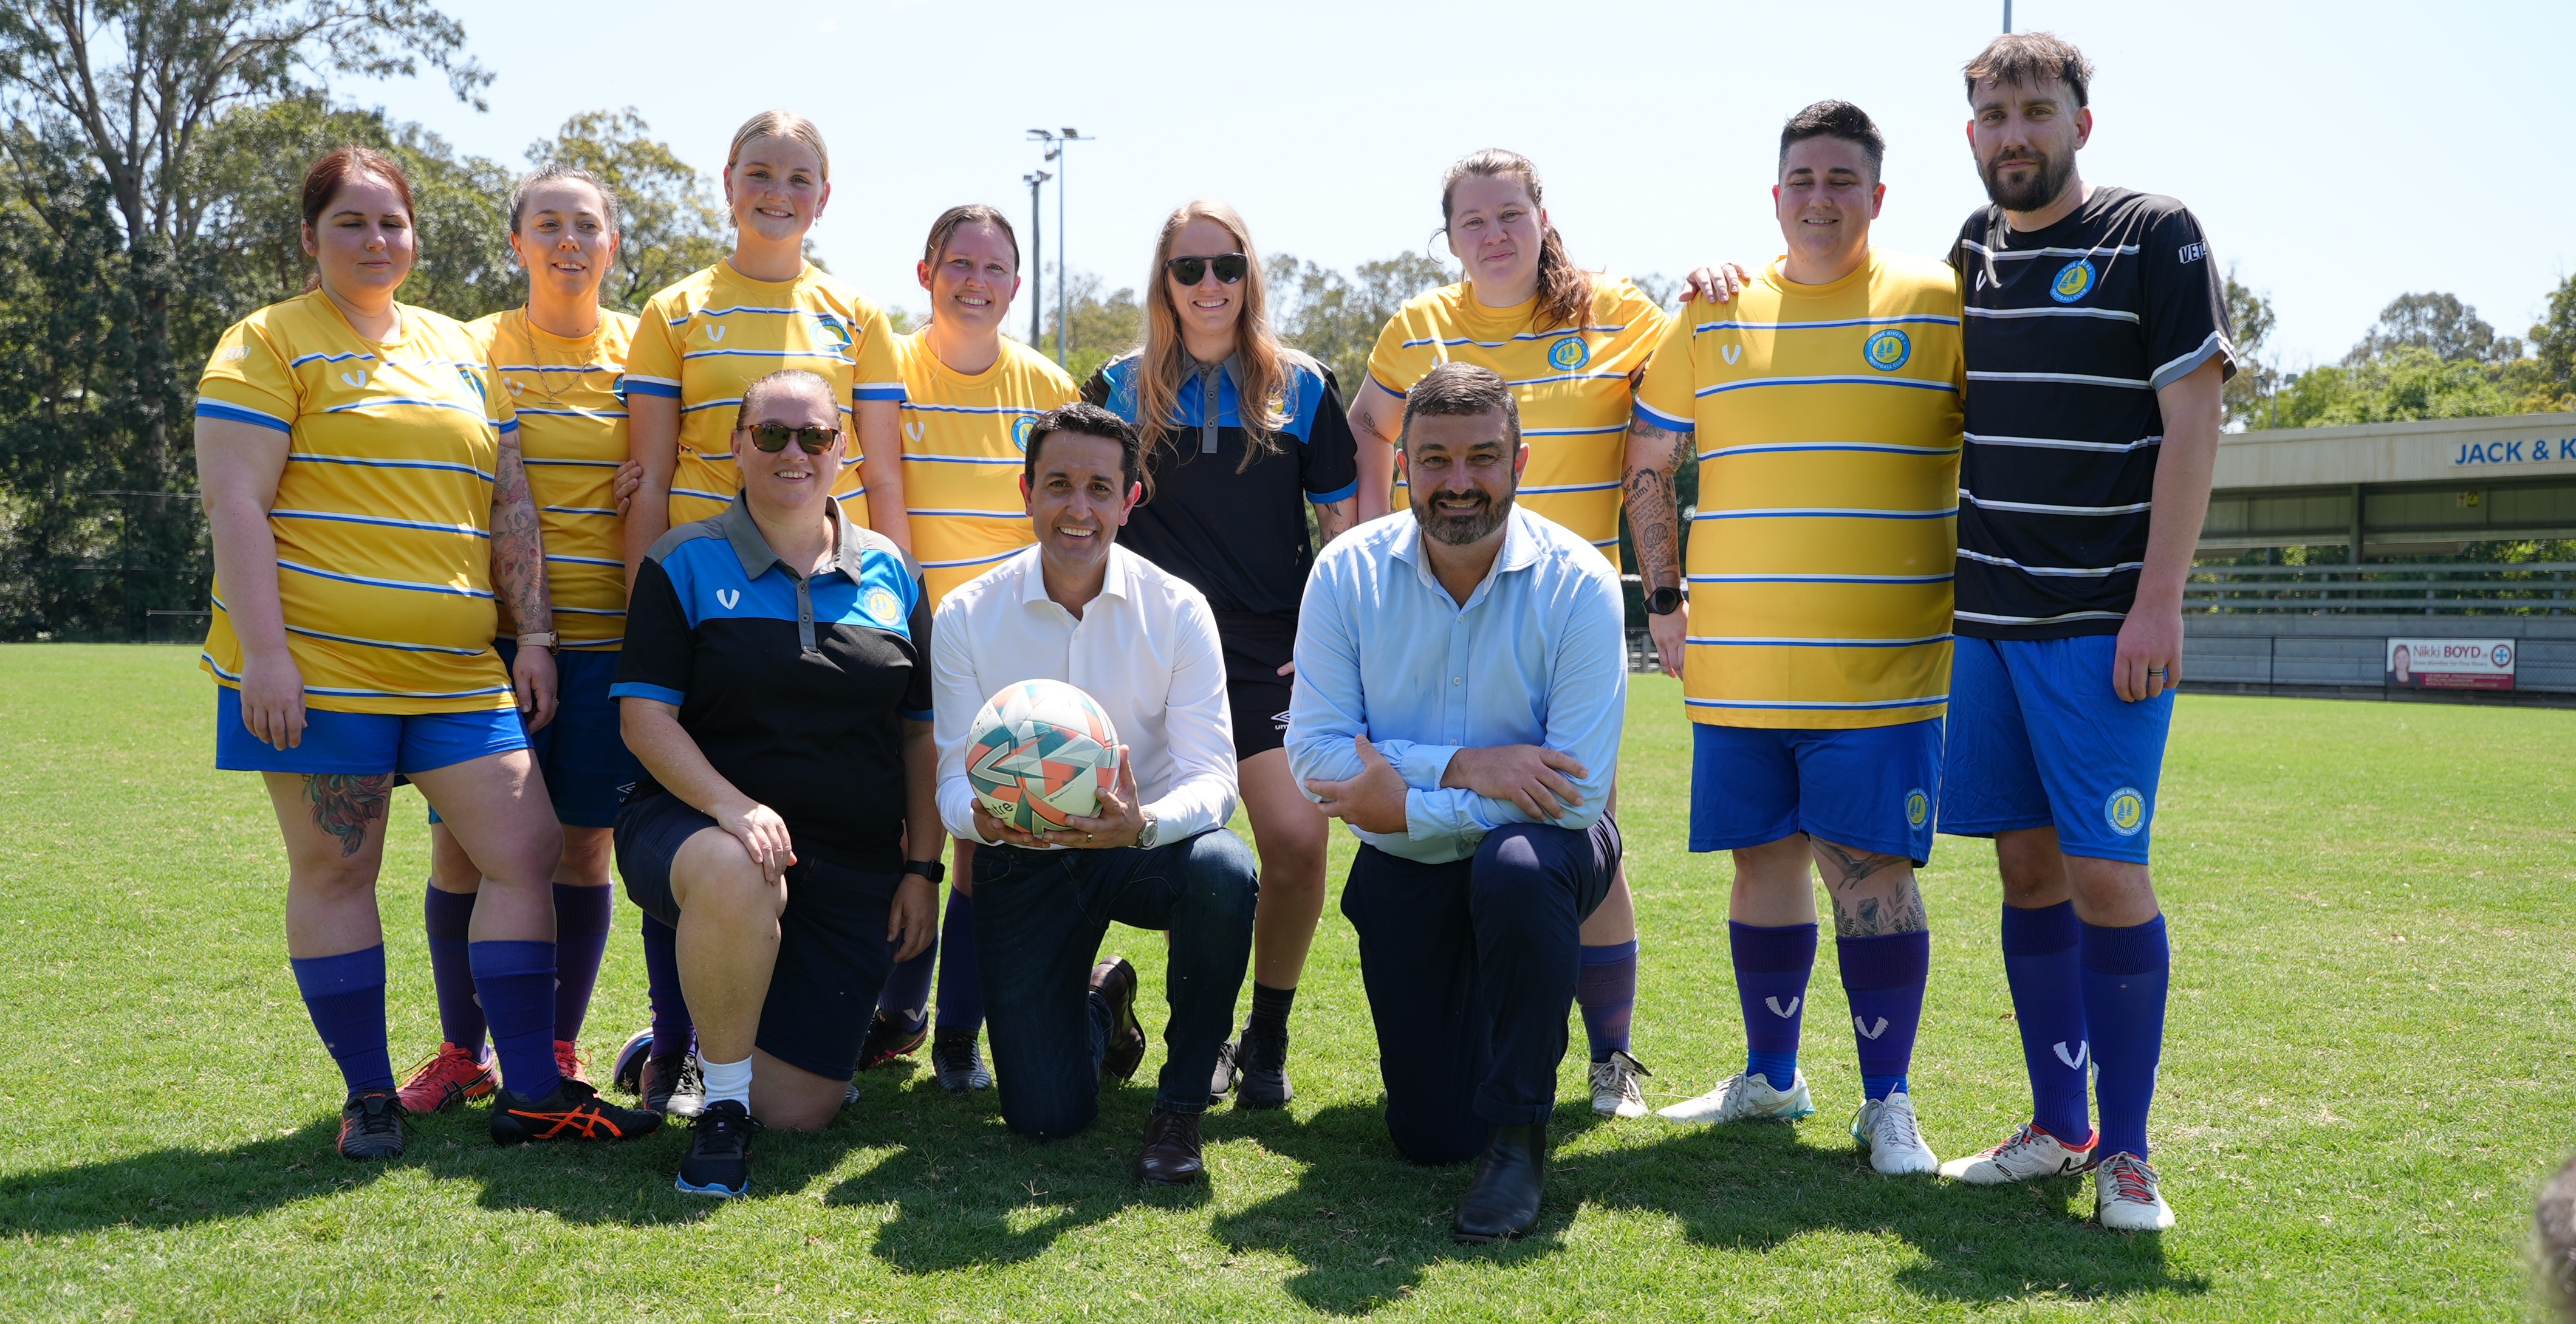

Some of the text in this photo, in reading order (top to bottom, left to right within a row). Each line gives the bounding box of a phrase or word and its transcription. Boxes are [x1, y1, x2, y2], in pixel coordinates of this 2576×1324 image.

[1873, 331, 1906, 341] PINE RIVERS
[1868, 356, 1905, 369] FOOTBALL CLUB
[2455, 441, 2523, 464] JACK
[2532, 440, 2549, 461] &
[2413, 645, 2441, 658] Nikki
[2444, 646, 2481, 659] BOYD
[2112, 789, 2142, 802] PINE RIVERS
[2109, 818, 2142, 834] FOOTBALL CLUB
